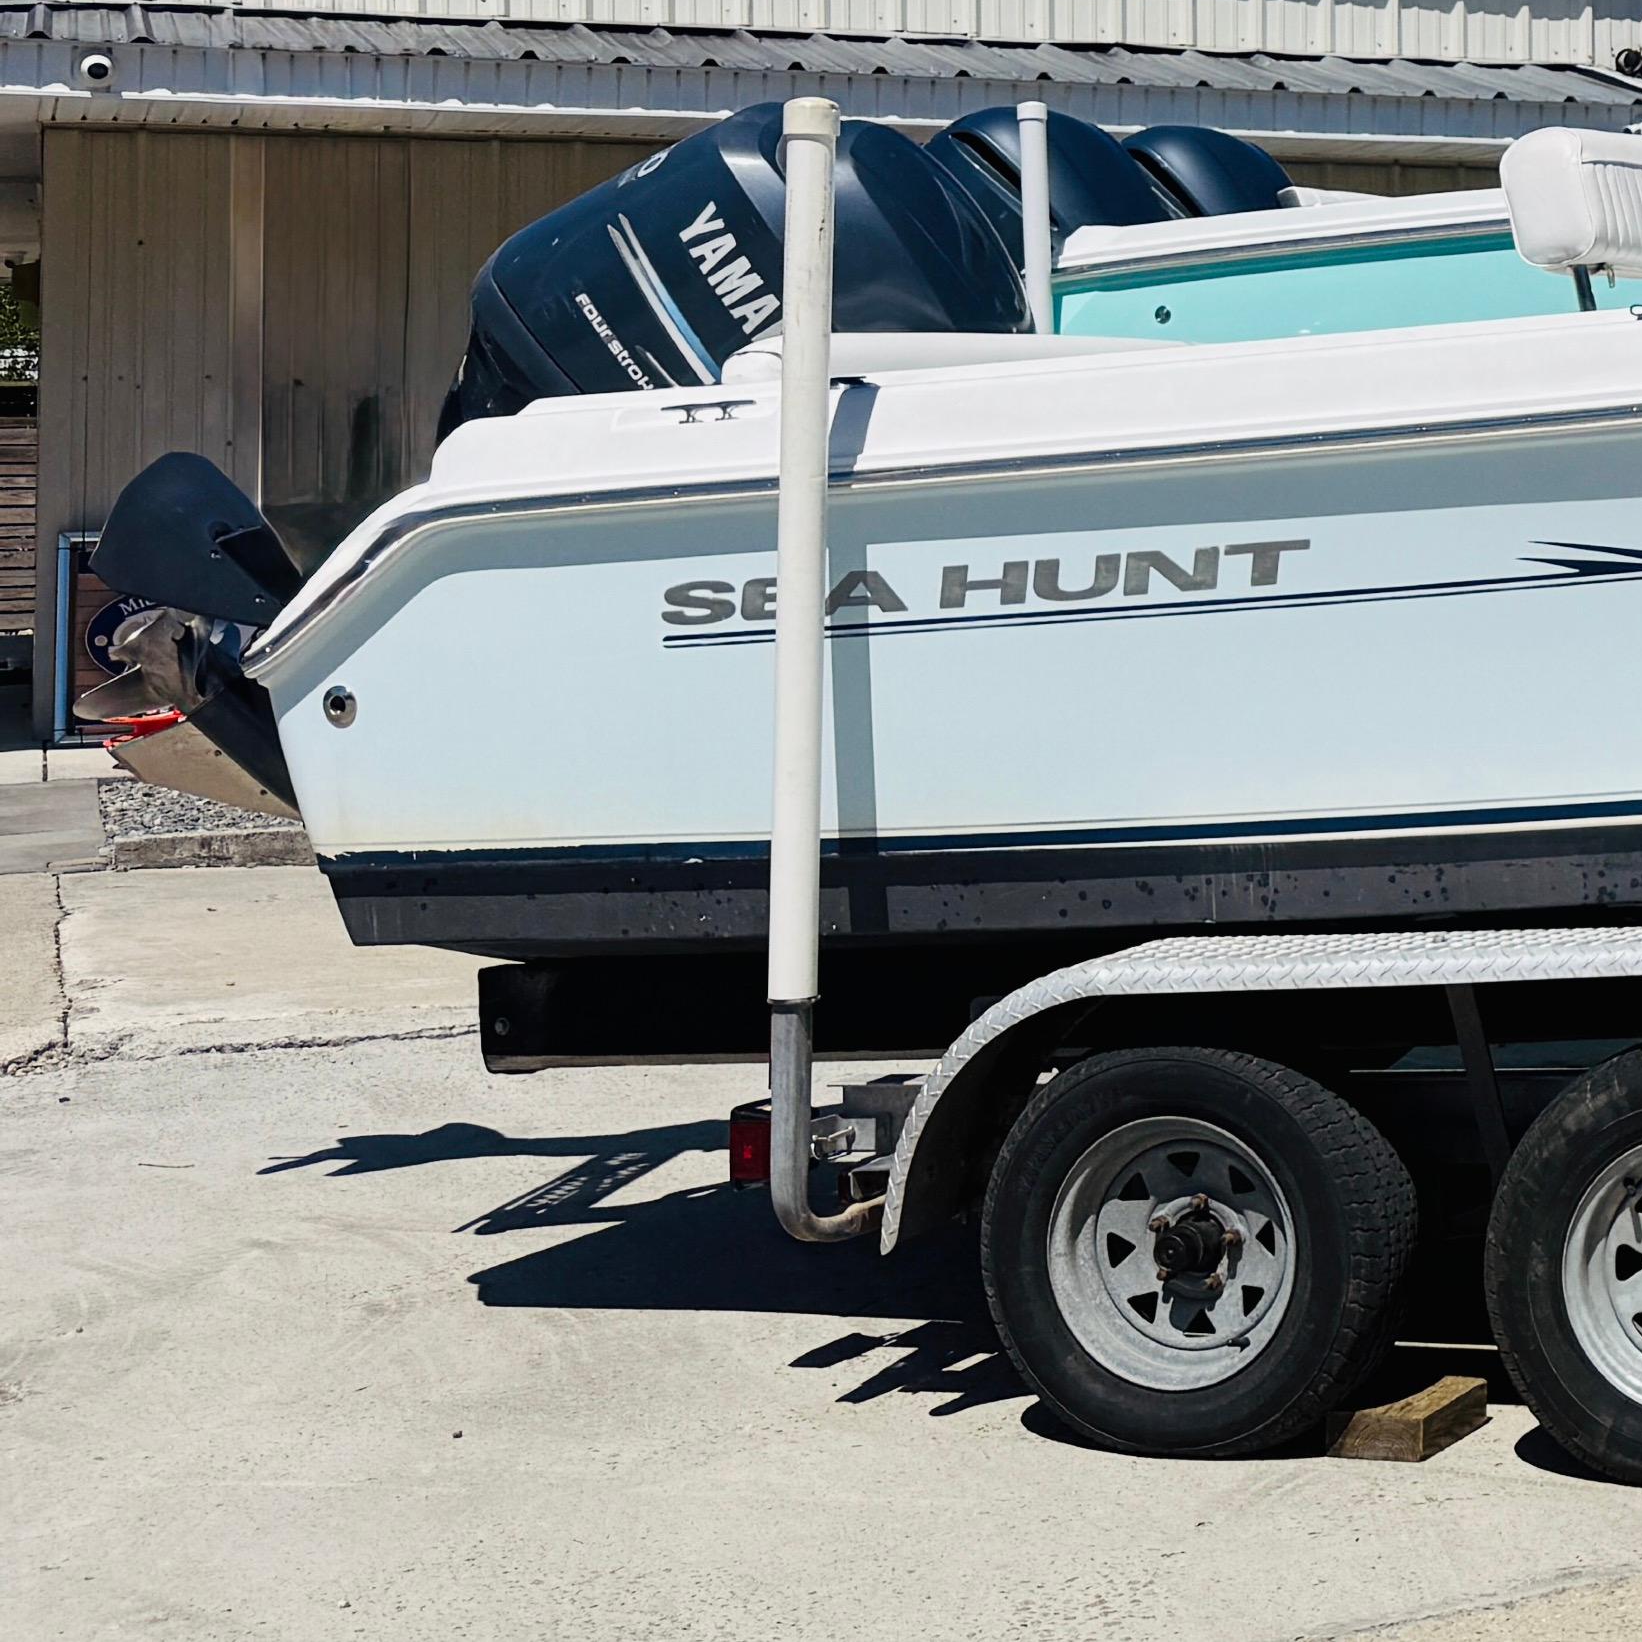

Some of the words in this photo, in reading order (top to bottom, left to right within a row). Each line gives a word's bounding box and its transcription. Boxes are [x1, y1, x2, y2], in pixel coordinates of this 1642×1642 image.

[679, 201, 783, 342] YAMA
[661, 570, 908, 626] SEA
[939, 538, 1311, 609] HUNT
